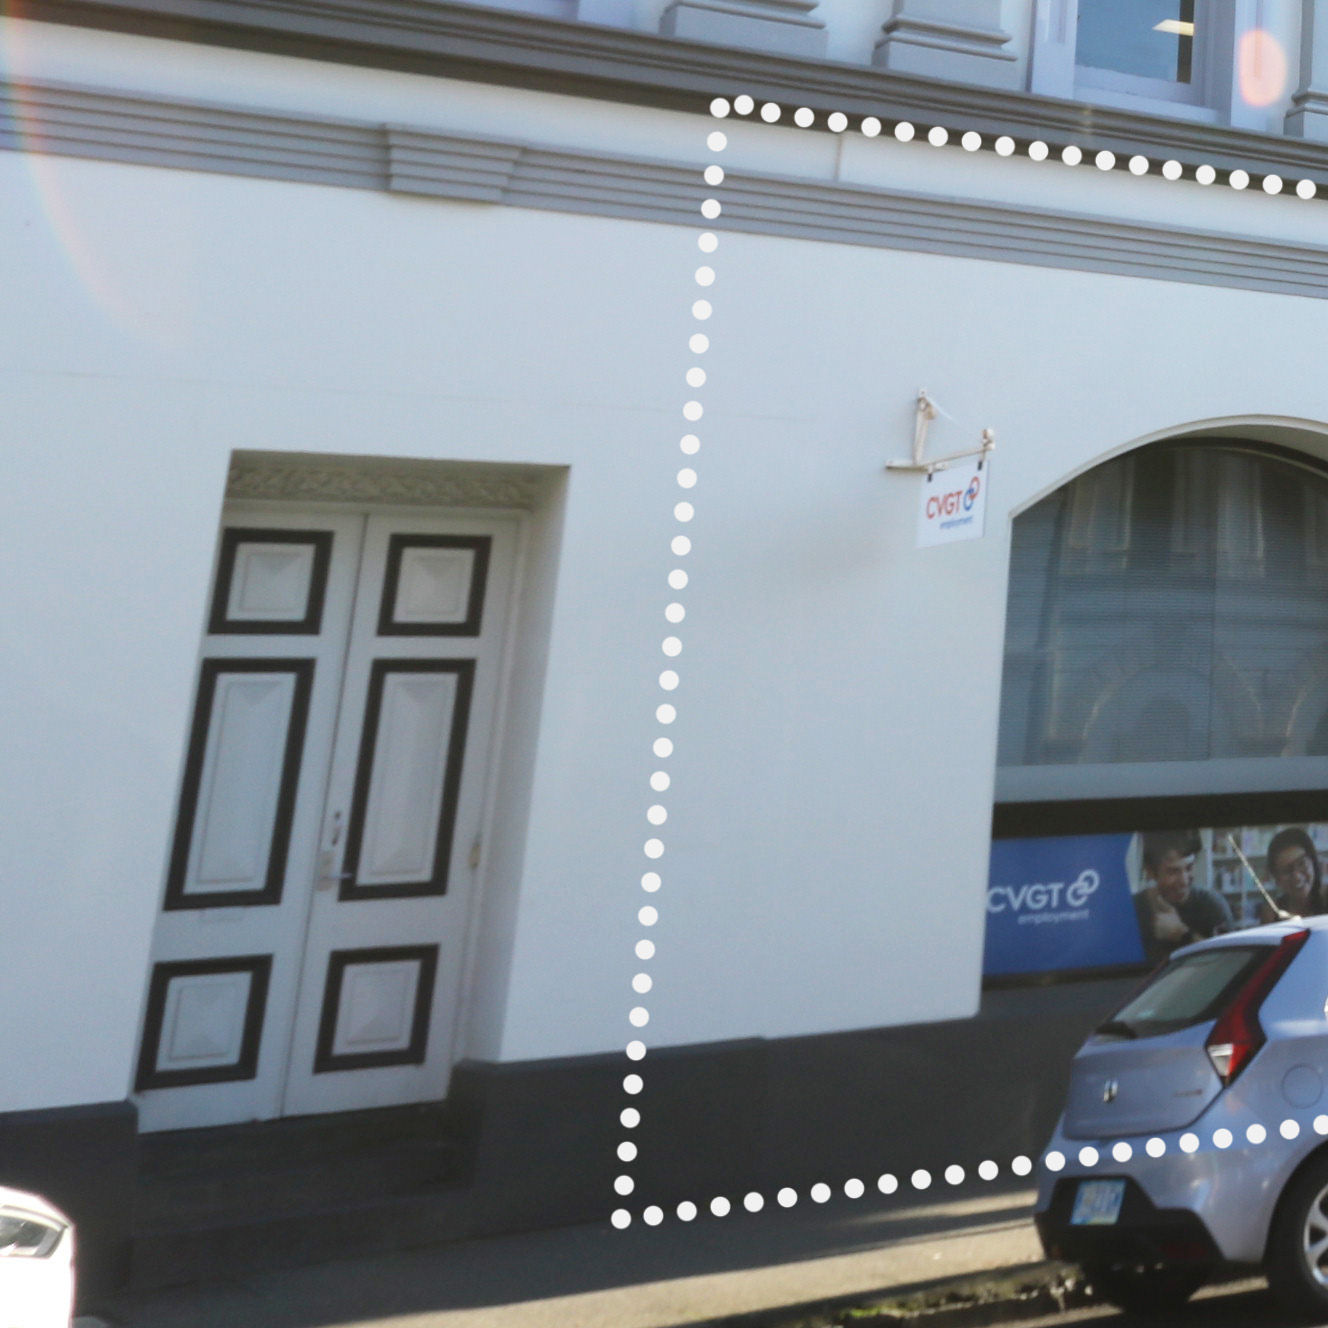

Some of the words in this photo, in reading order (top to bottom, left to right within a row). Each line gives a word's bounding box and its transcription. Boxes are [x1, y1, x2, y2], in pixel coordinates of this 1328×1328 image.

[926, 490, 963, 519] CVGT
[986, 883, 1065, 913] CVGT
[1017, 908, 1090, 925] employment
